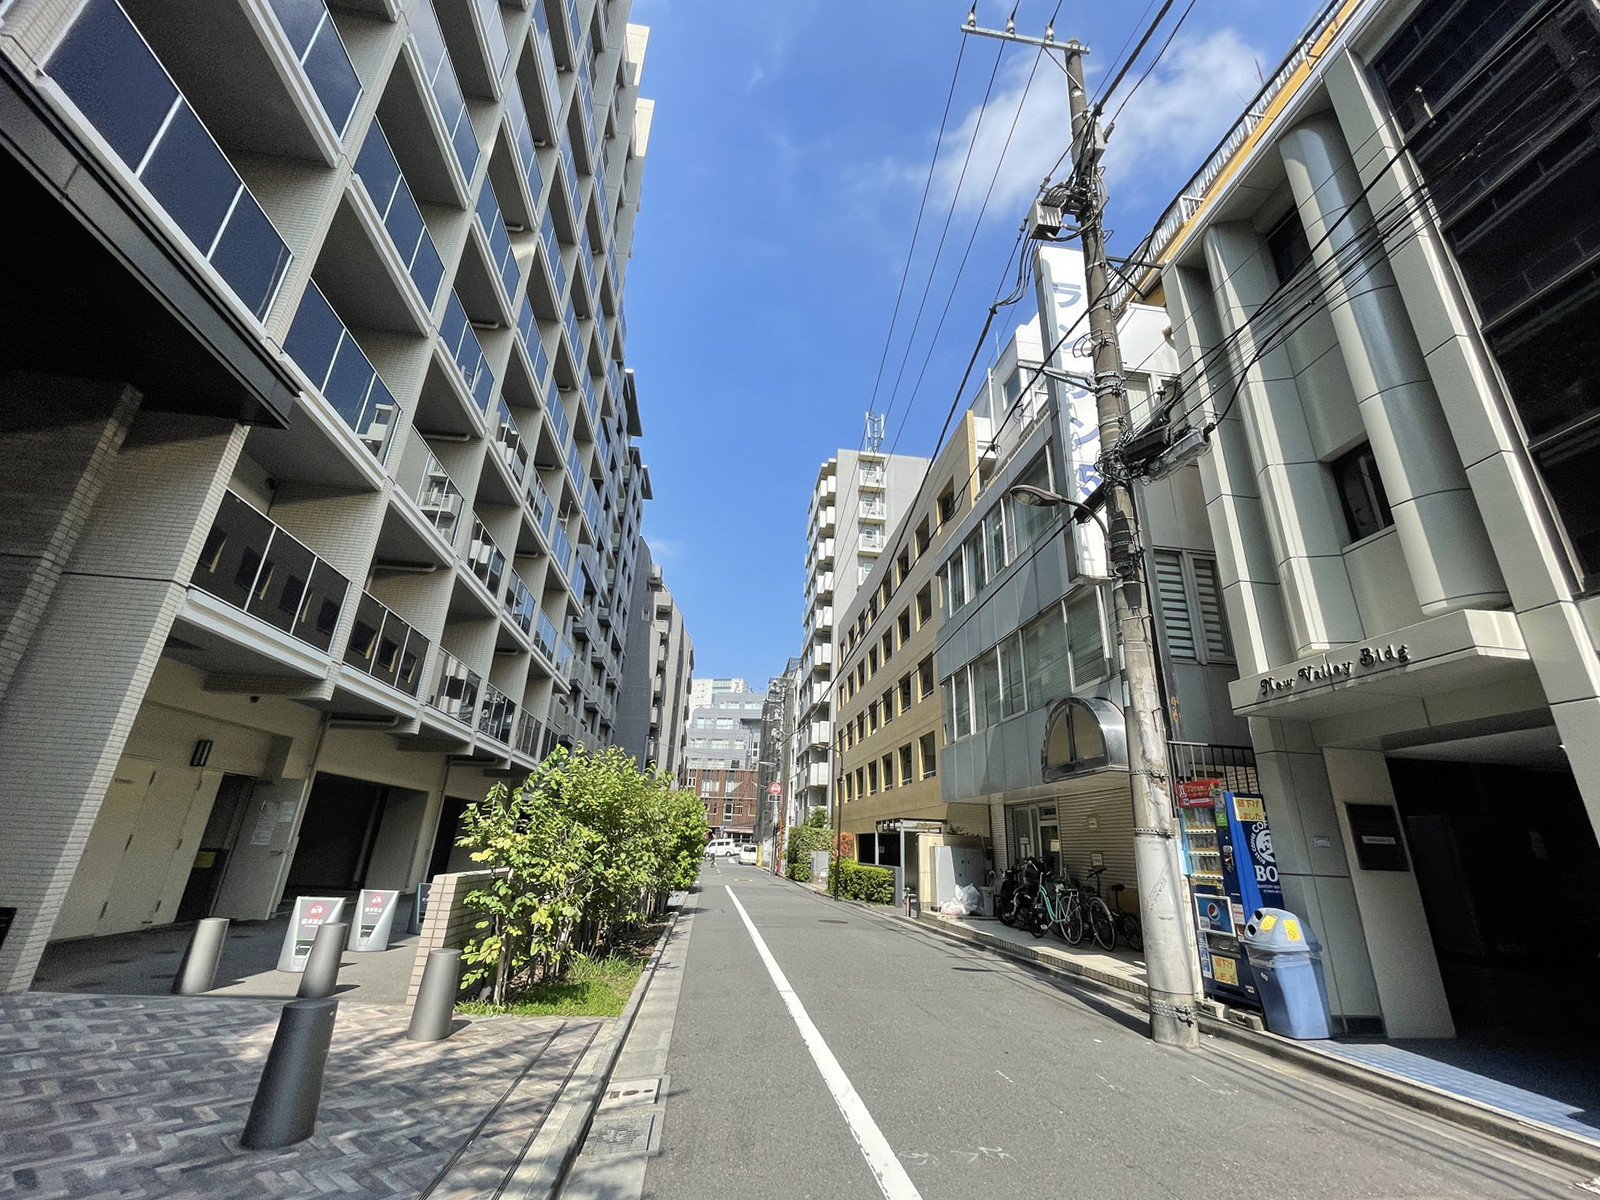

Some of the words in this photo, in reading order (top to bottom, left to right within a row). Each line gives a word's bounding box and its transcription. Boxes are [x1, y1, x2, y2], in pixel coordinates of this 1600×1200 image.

[1260, 676, 1294, 696] New
[1297, 661, 1353, 682] Valley
[1360, 644, 1410, 667] Bldg
[1255, 865, 1279, 882] BO
